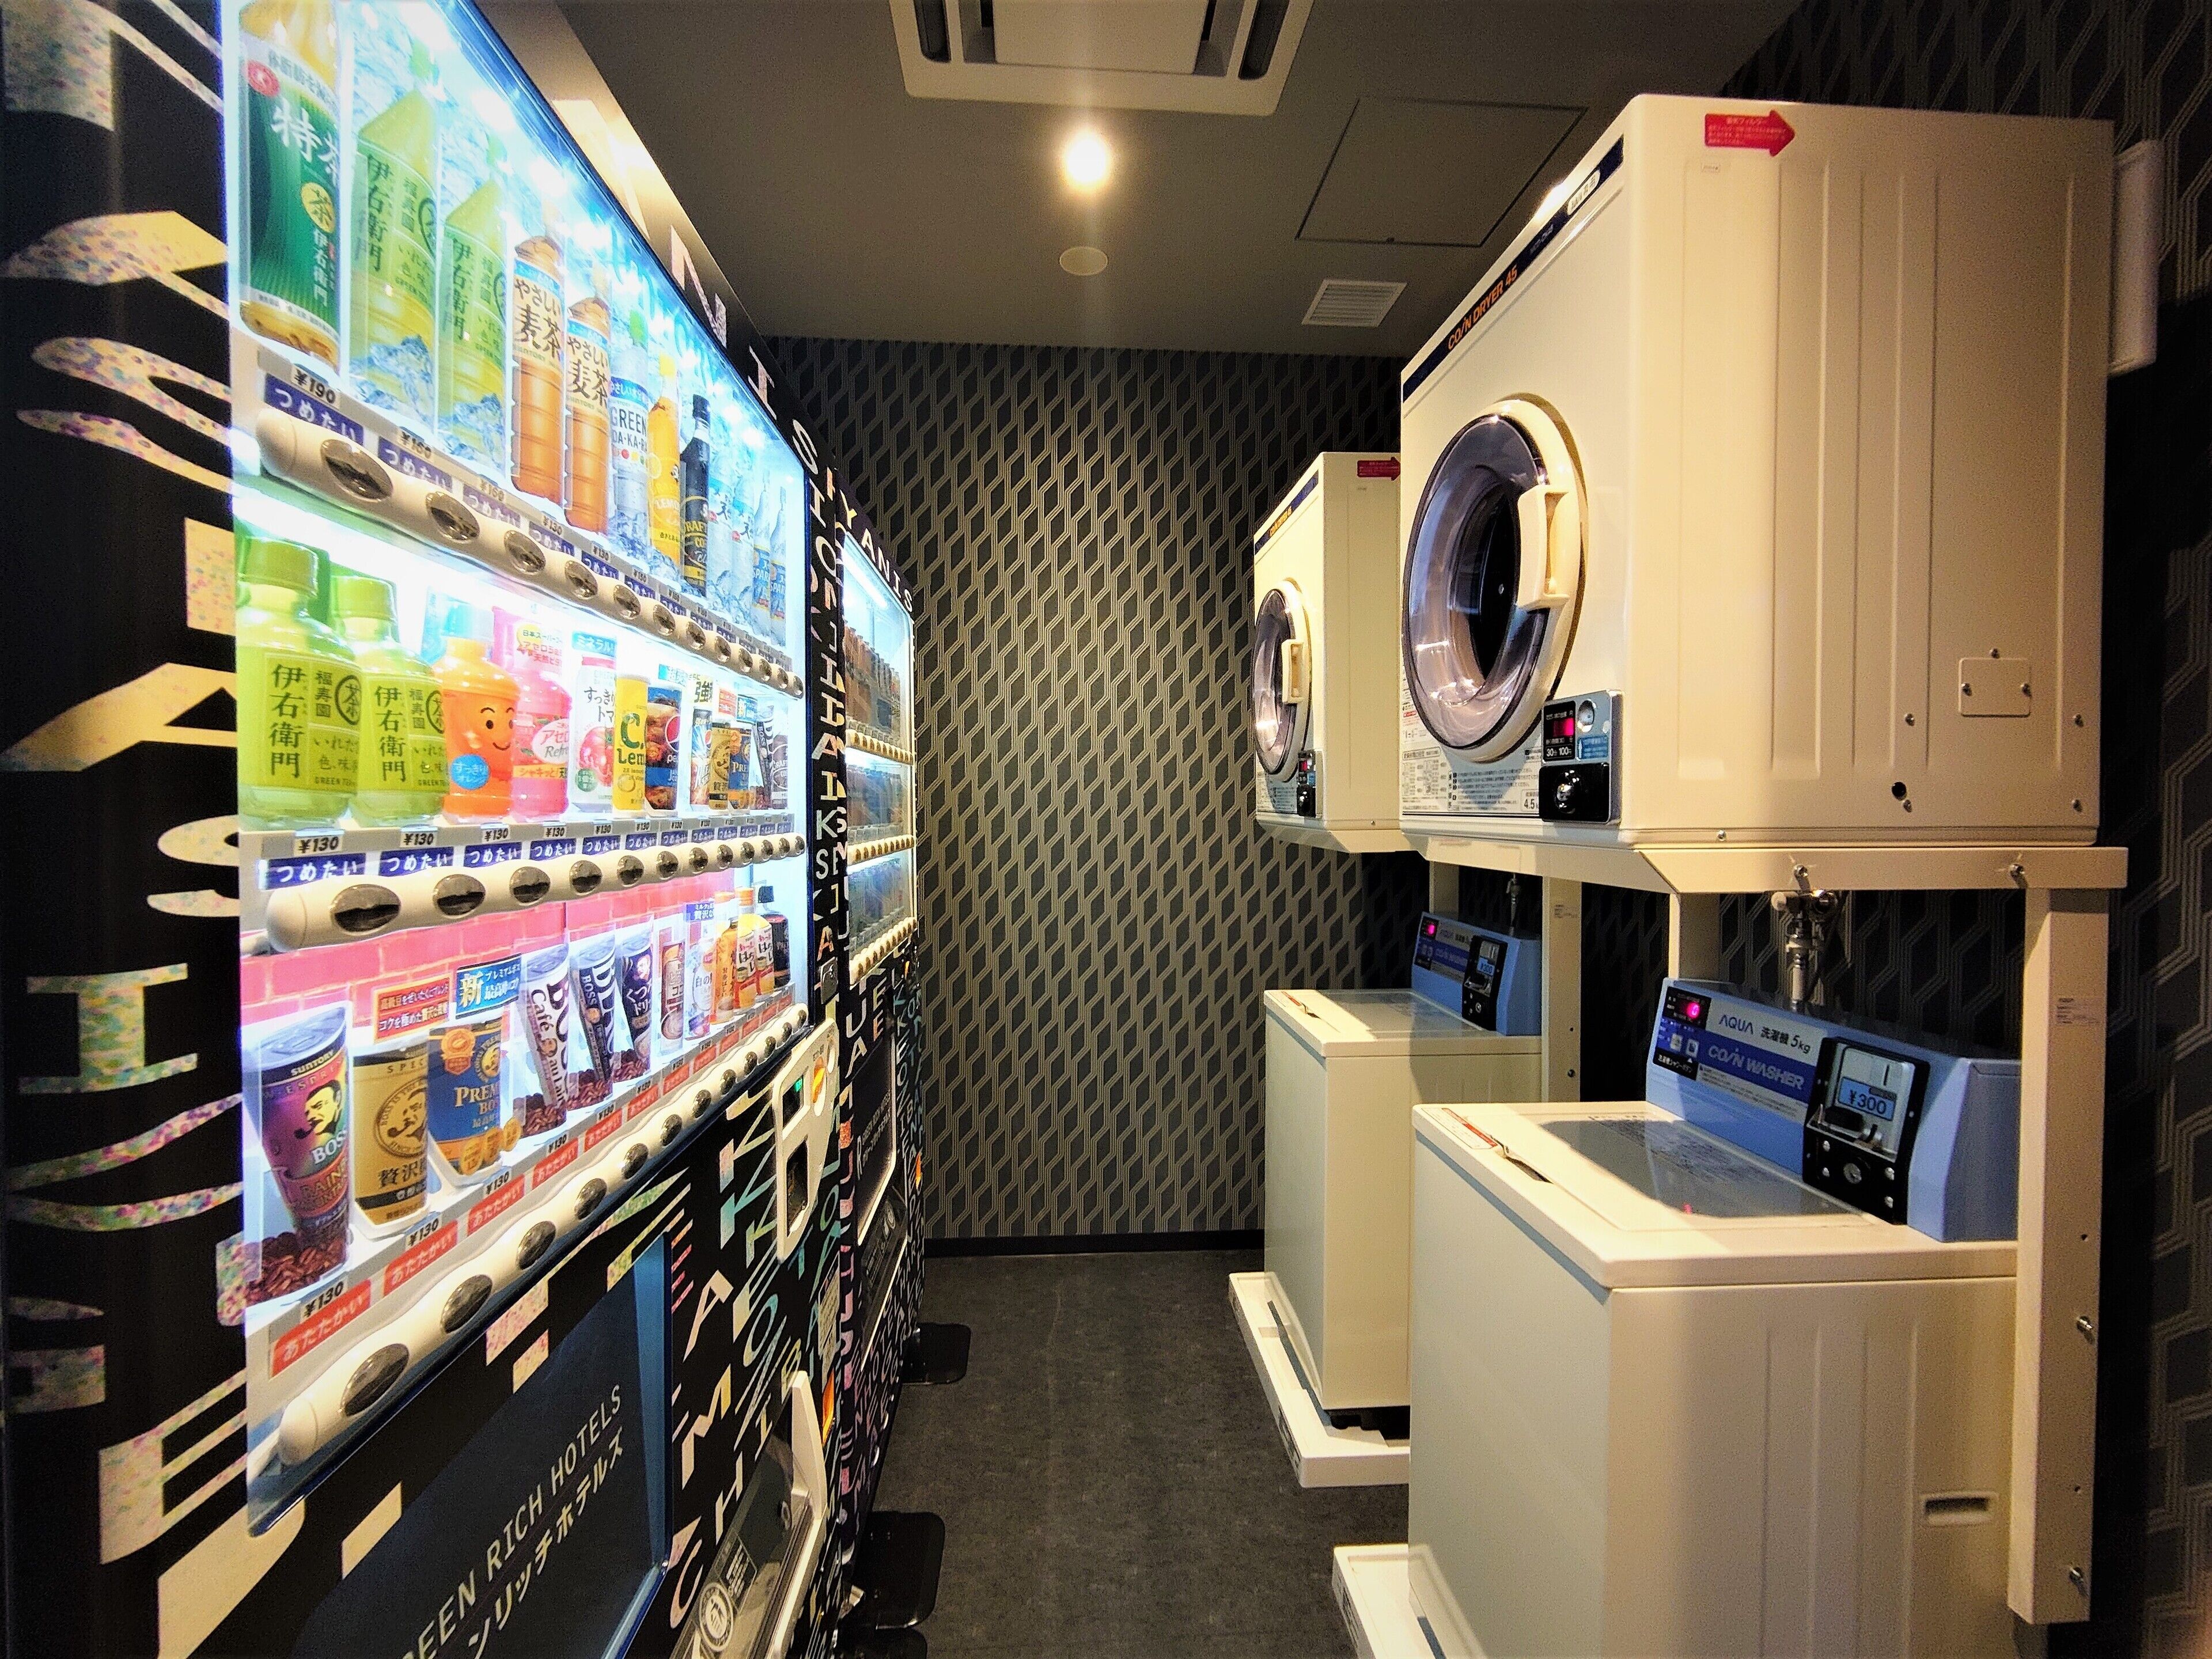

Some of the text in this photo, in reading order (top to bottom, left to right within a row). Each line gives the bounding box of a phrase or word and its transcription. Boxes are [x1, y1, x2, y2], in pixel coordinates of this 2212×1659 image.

[1506, 264, 1518, 285] 45
[514, 304, 561, 358] 麦茶
[294, 368, 336, 404] ¥190
[568, 359, 608, 407] 麦茶
[268, 664, 306, 779] 伊右衛門
[374, 686, 406, 782] 伊右衛門
[403, 833, 434, 845] ¥130
[484, 828, 509, 842] ¥130
[546, 827, 565, 838] ¥130
[596, 825, 611, 835] ¥130
[298, 837, 339, 853] ¥130
[470, 847, 519, 864] つめたい
[532, 844, 574, 858] つめたい
[277, 860, 357, 883] つめたい
[388, 853, 448, 872] つめたい
[460, 971, 484, 1008] 新
[1790, 1035, 1810, 1055] 5kg
[290, 1050, 335, 1075] SUNTORY
[1747, 1058, 1804, 1090] WASHER
[1848, 1089, 1887, 1116] ¥300
[549, 1134, 567, 1154] ¥130
[484, 1172, 509, 1195] ¥130
[408, 1221, 439, 1247] ¥130
[392, 1233, 452, 1286] あたたかい
[304, 1281, 344, 1319] ¥130
[283, 1297, 365, 1361] あたたかい
[403, 1384, 622, 1659] EEN RICH HOTELS
